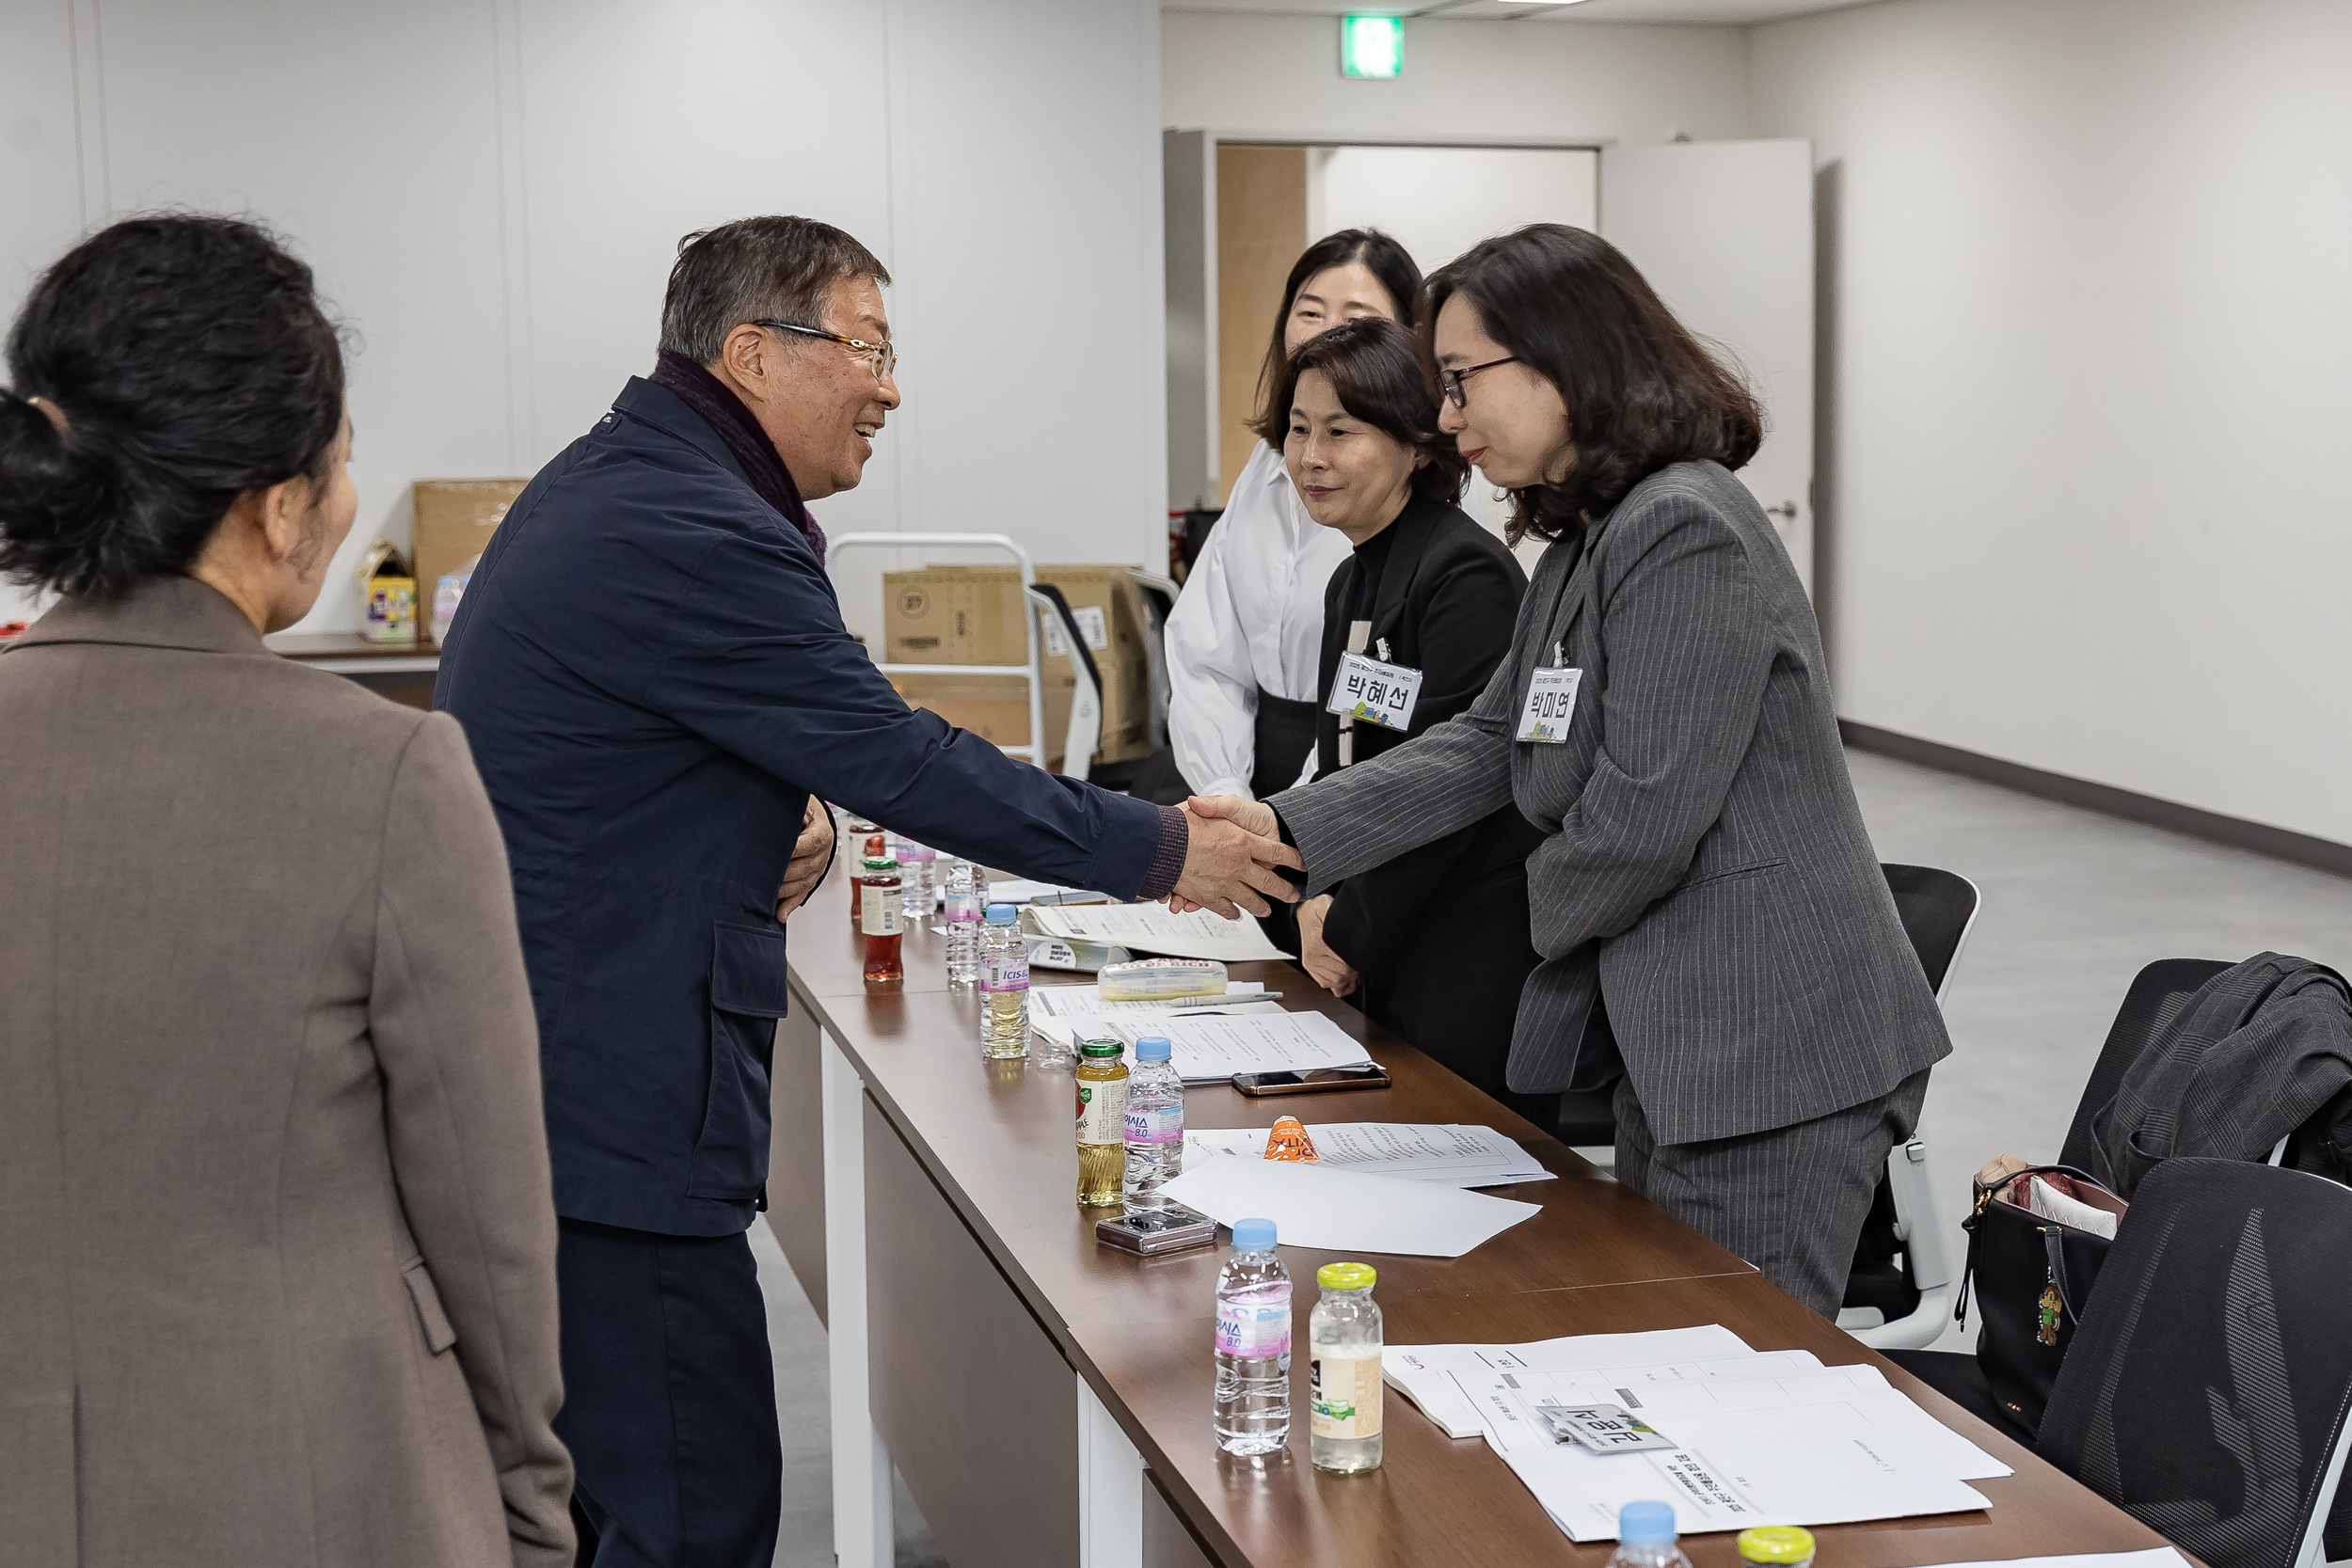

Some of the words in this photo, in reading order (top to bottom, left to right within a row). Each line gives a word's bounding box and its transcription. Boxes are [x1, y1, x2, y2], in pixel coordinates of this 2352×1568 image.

[1345, 673, 1408, 711] 박혜선
[1531, 691, 1570, 719] 박미연
[1003, 971, 1021, 979] ICIS
[1135, 1129, 1148, 1138] 8.0
[1226, 1337, 1241, 1348] 8.0
